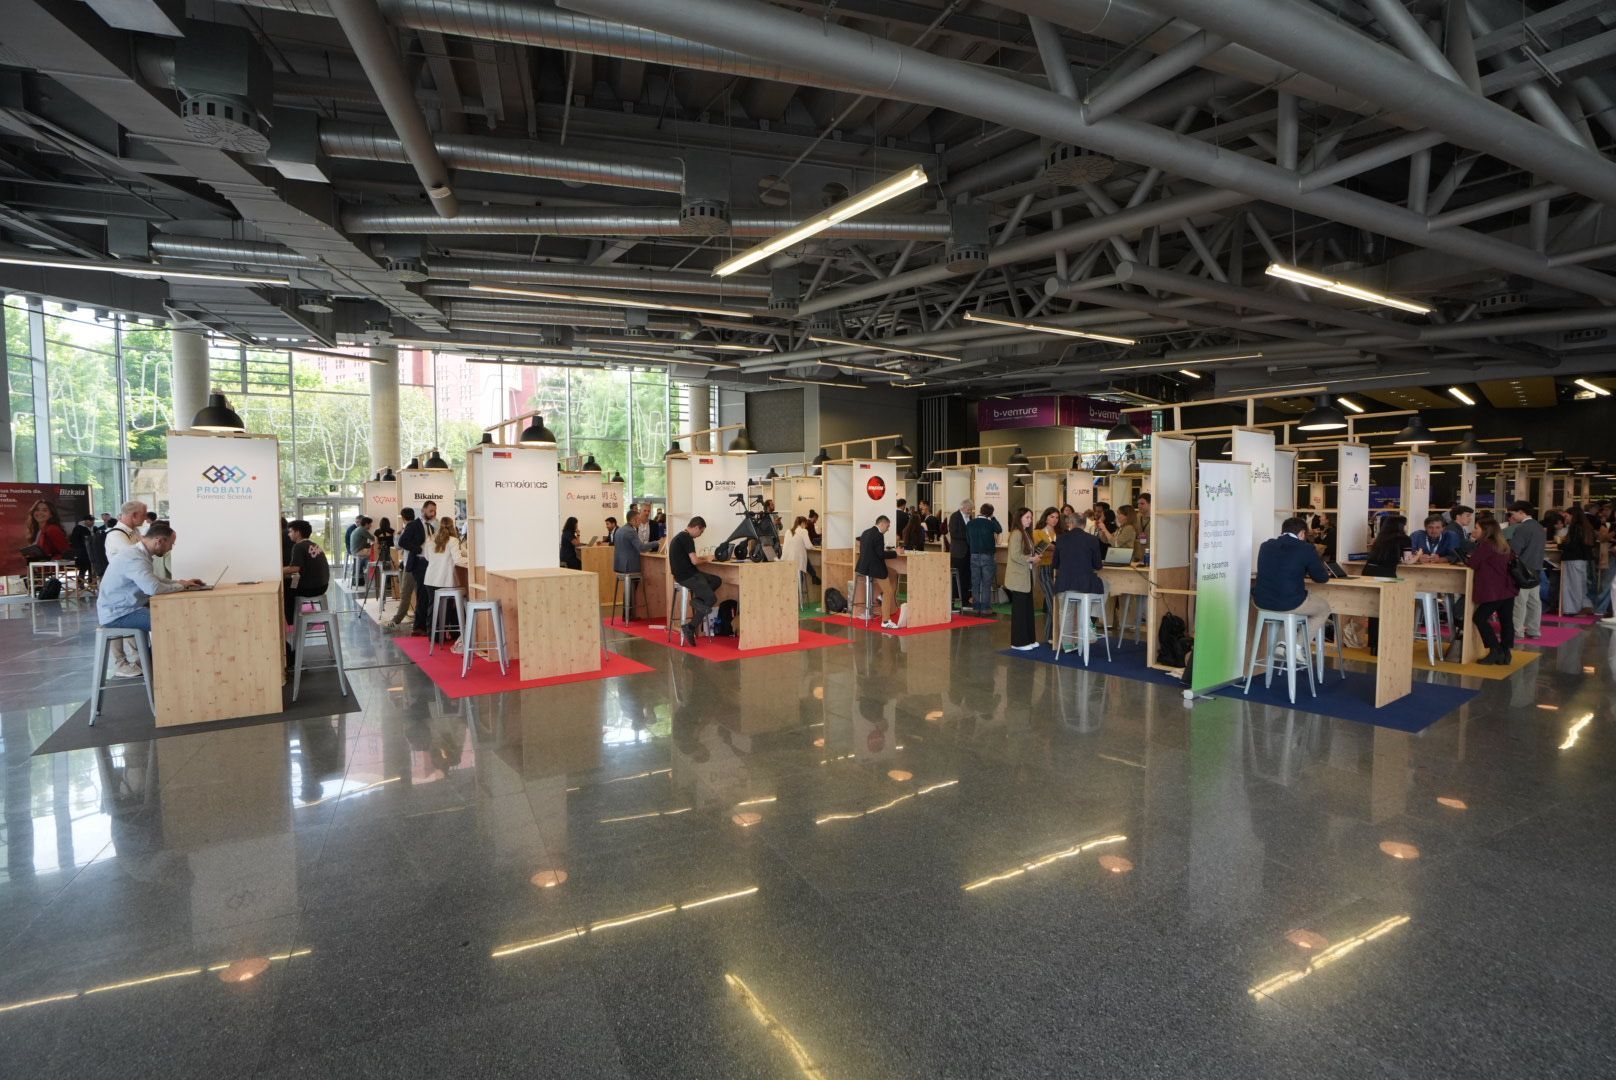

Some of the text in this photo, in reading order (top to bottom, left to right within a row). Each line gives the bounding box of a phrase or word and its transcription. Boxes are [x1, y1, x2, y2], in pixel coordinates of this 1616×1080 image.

[59, 488, 86, 496] Bizkaia
[196, 486, 252, 494] PROBATIA
[414, 492, 444, 500] Bikaine
